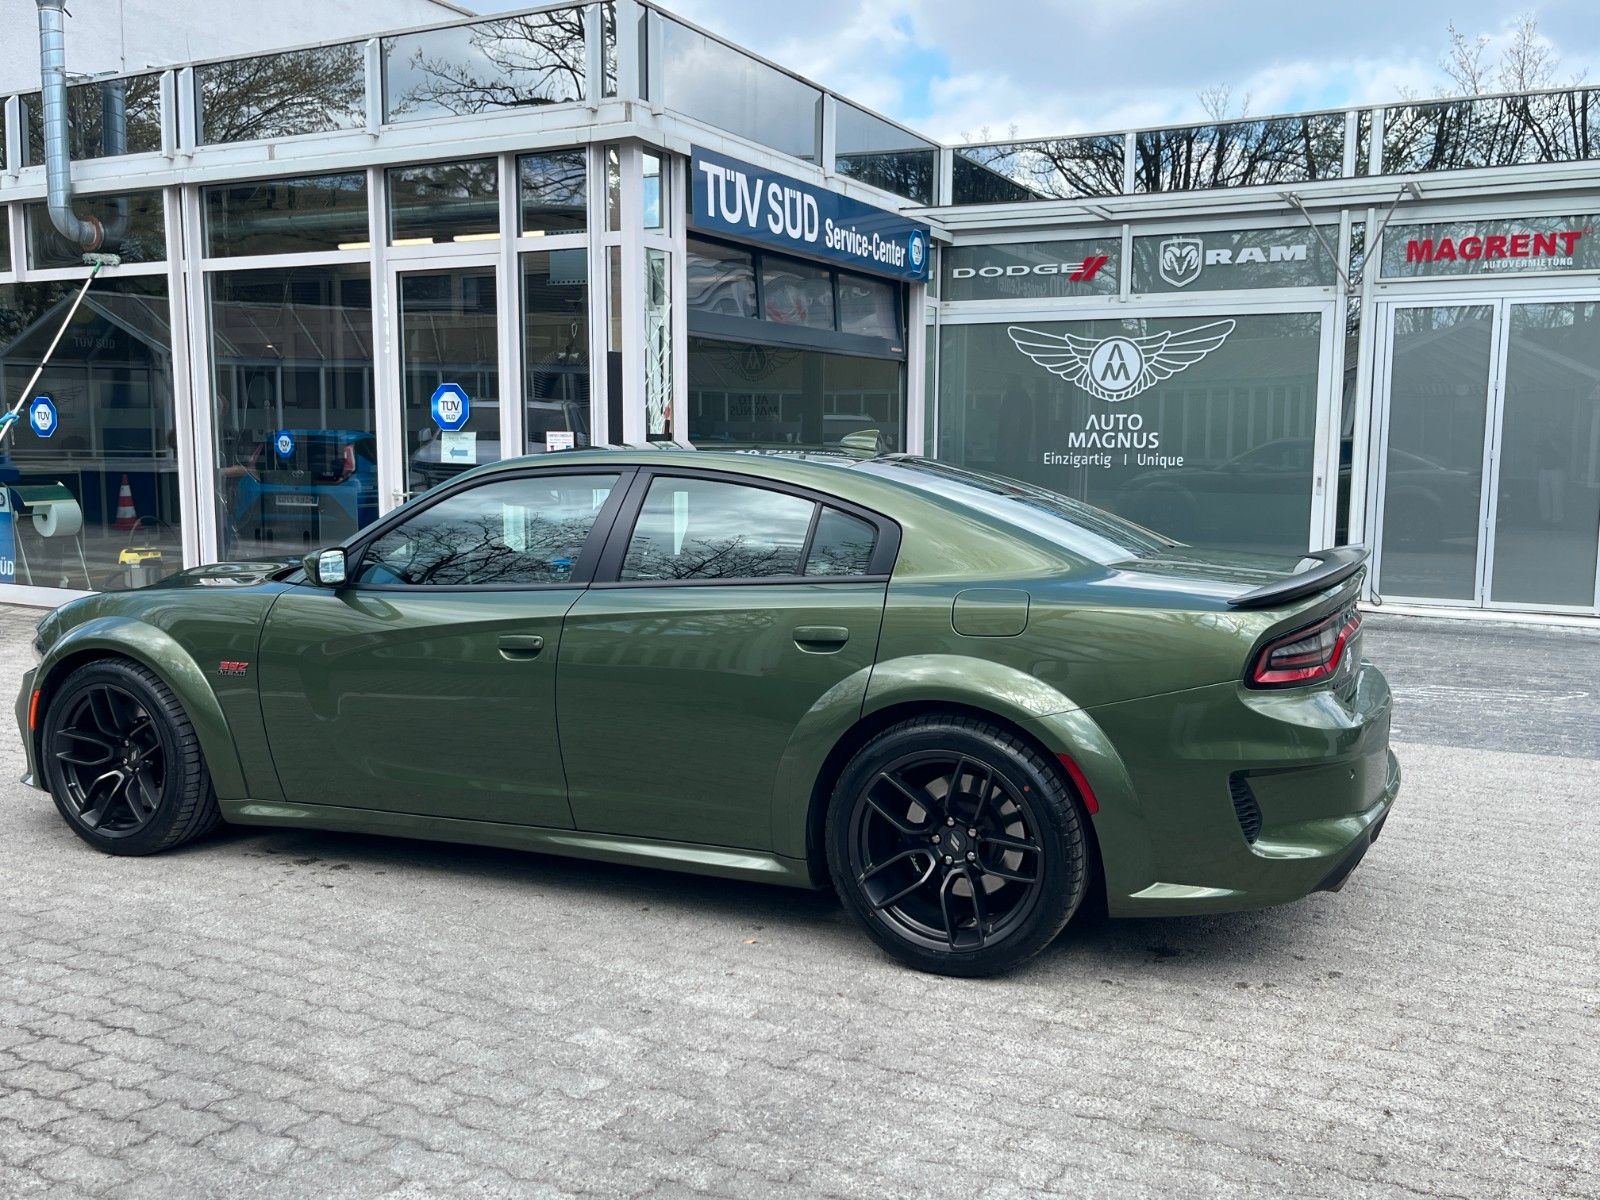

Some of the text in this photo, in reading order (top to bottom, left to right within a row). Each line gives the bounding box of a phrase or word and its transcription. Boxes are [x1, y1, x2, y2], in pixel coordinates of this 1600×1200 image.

[699, 160, 906, 268] TÜV SÜD Service-Center
[1206, 245, 1307, 266] RAM
[1406, 231, 1582, 264] MAGRENT
[952, 262, 1085, 280] DODGE
[1482, 257, 1573, 269] AUTOVERMIETUNG
[1085, 413, 1143, 431] AUTO
[1068, 432, 1159, 449] MAGNUS
[1043, 452, 1112, 469] Einzigartig
[1137, 453, 1184, 468] Unique
